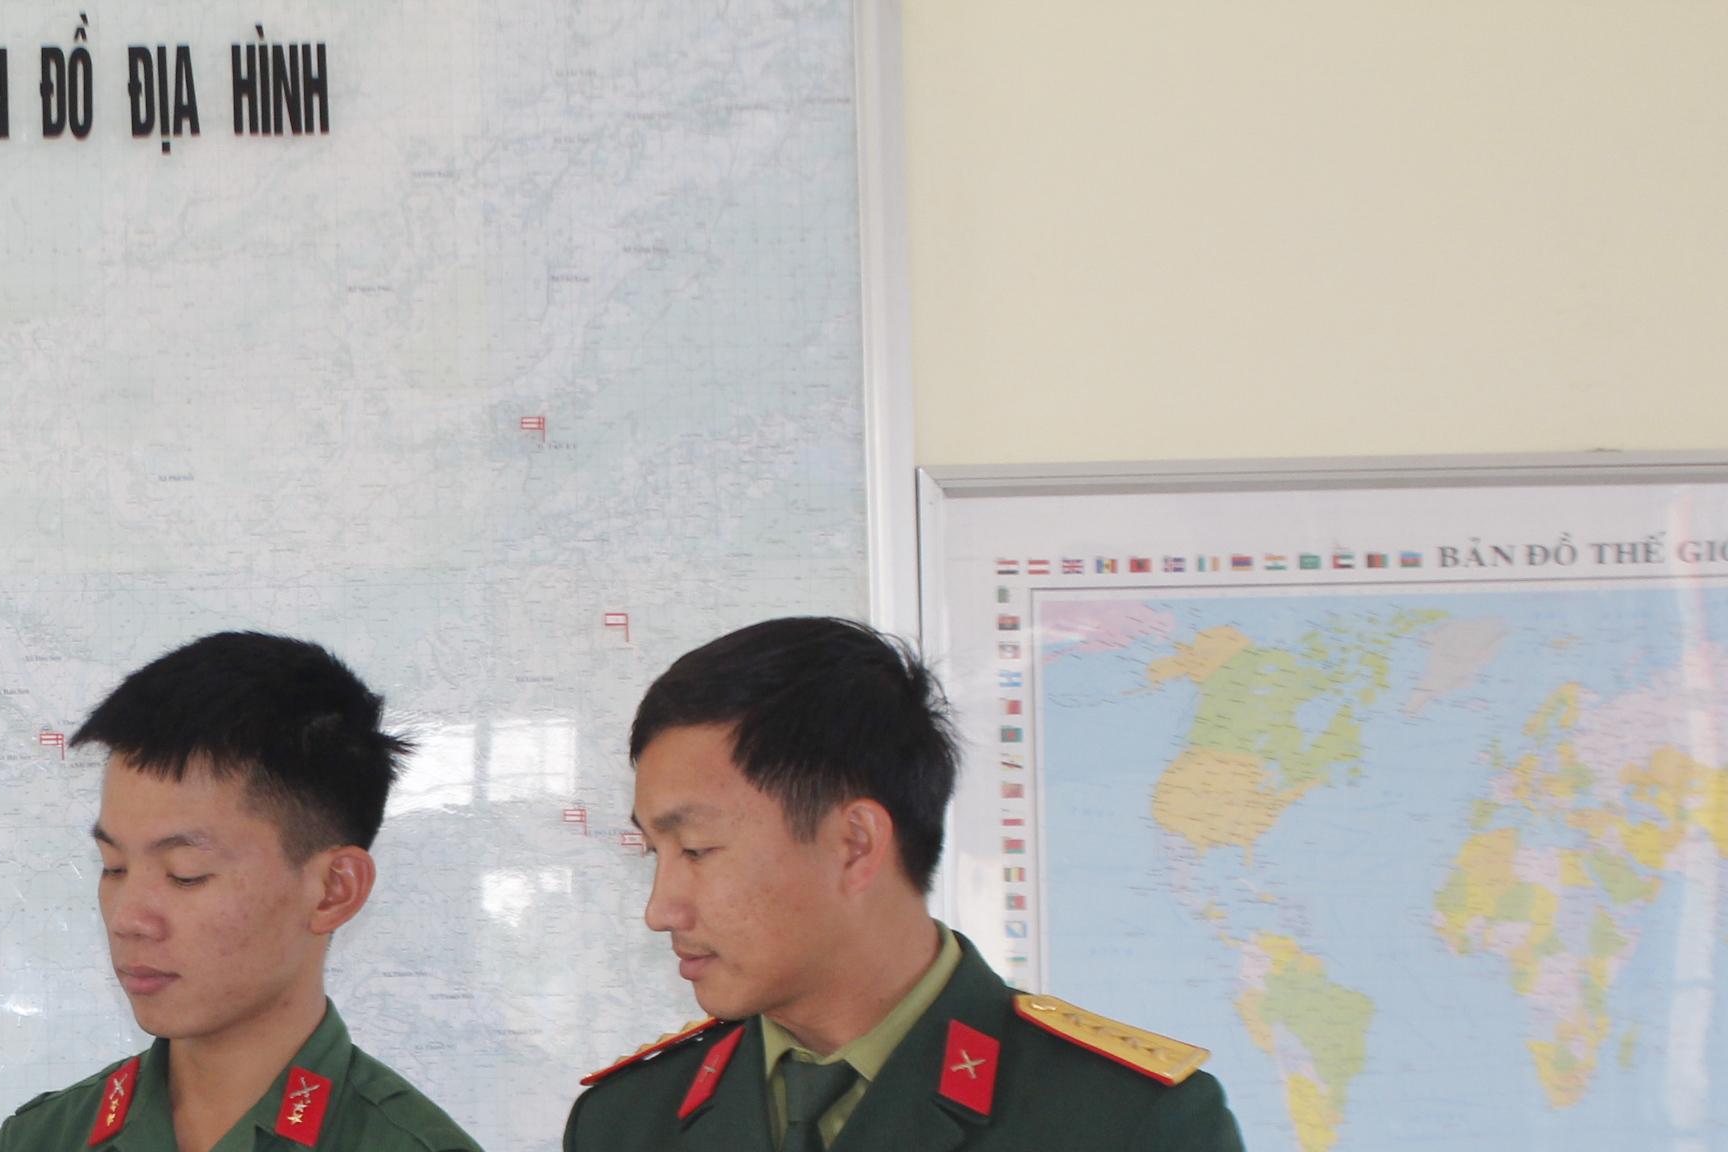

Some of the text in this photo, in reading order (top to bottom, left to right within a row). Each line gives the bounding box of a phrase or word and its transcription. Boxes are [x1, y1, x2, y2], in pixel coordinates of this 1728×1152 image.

[39, 11, 93, 140] ĐỒ
[128, 44, 200, 154] ĐỊA
[231, 22, 330, 137] HÌNH
[1525, 531, 1578, 567] ĐỒ
